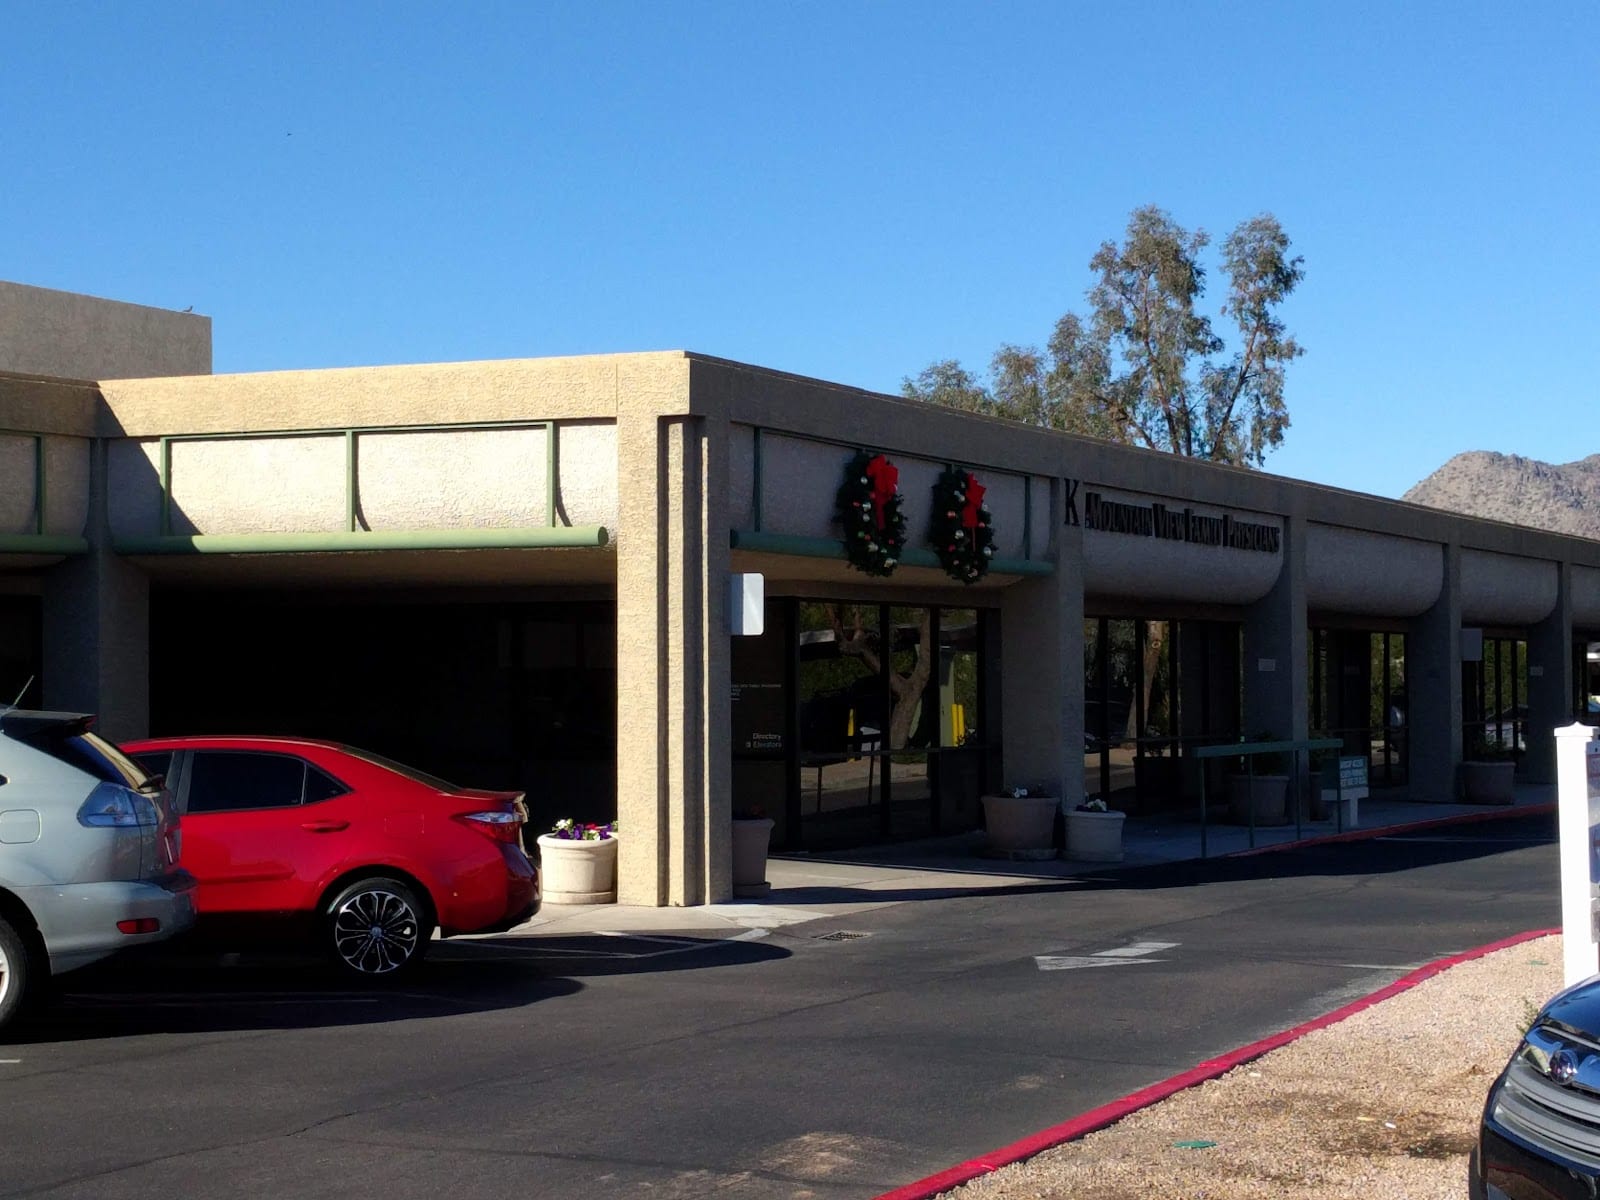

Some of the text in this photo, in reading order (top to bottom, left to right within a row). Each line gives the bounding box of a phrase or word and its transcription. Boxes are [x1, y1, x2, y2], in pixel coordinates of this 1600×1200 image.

[1064, 478, 1080, 526] K
[1085, 493, 1280, 552] MOUNTAIN VIEW FAMILY PHYSICIANS
